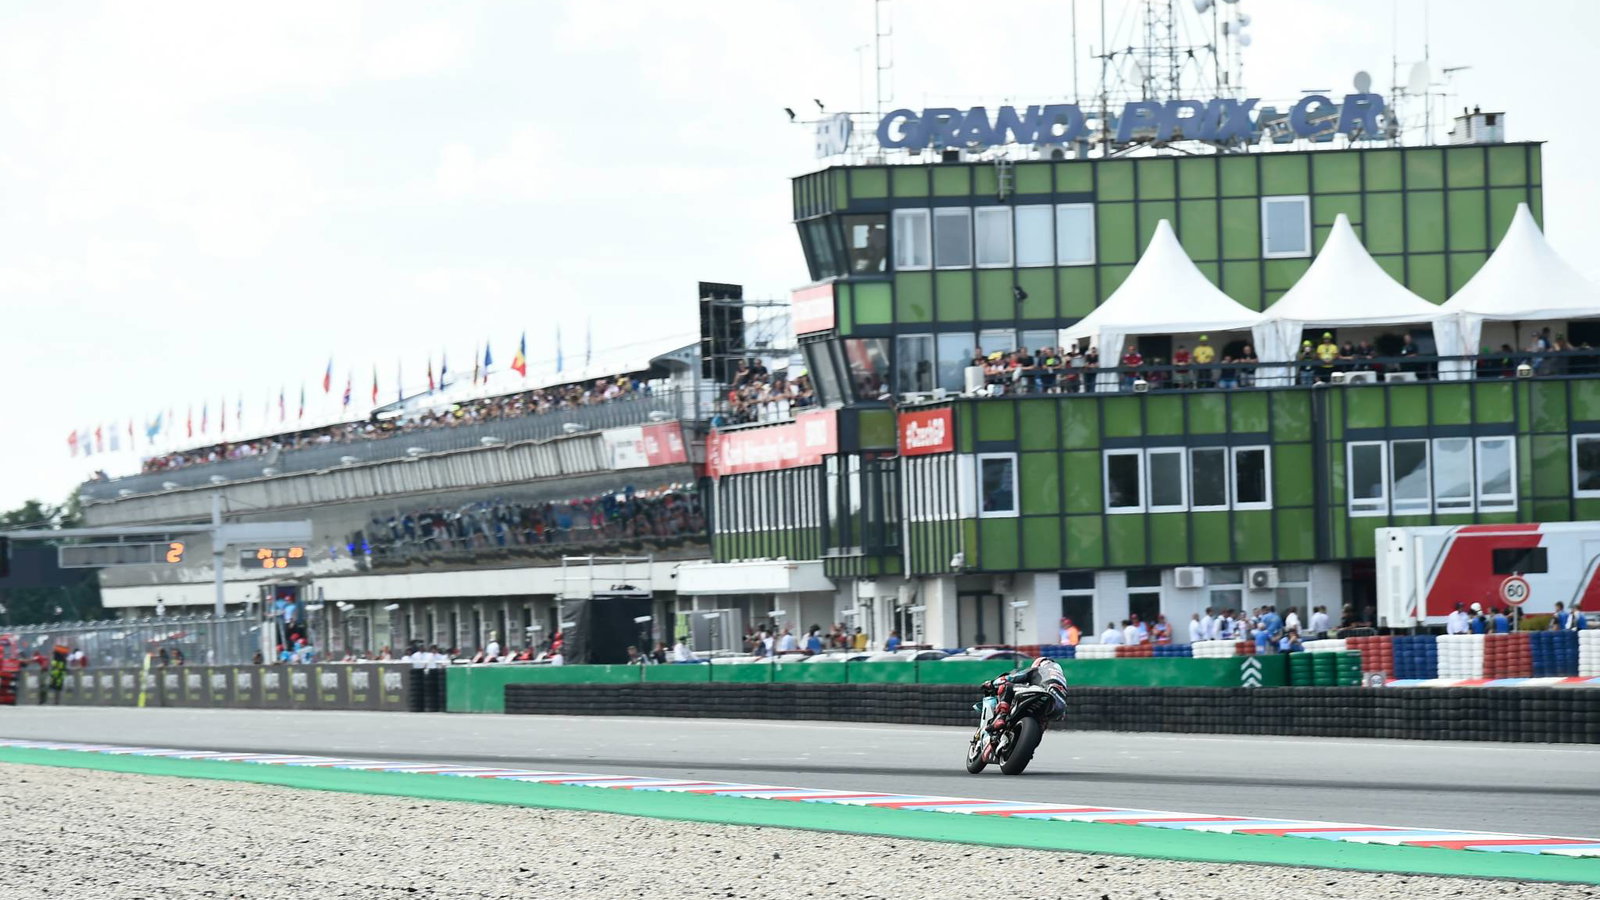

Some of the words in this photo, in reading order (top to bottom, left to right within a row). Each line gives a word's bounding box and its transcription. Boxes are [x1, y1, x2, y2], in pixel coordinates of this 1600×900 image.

[876, 104, 1084, 150] GRAND
[1114, 98, 1260, 144] PRIX
[166, 542, 184, 563] 2
[1508, 583, 1524, 598] 60
